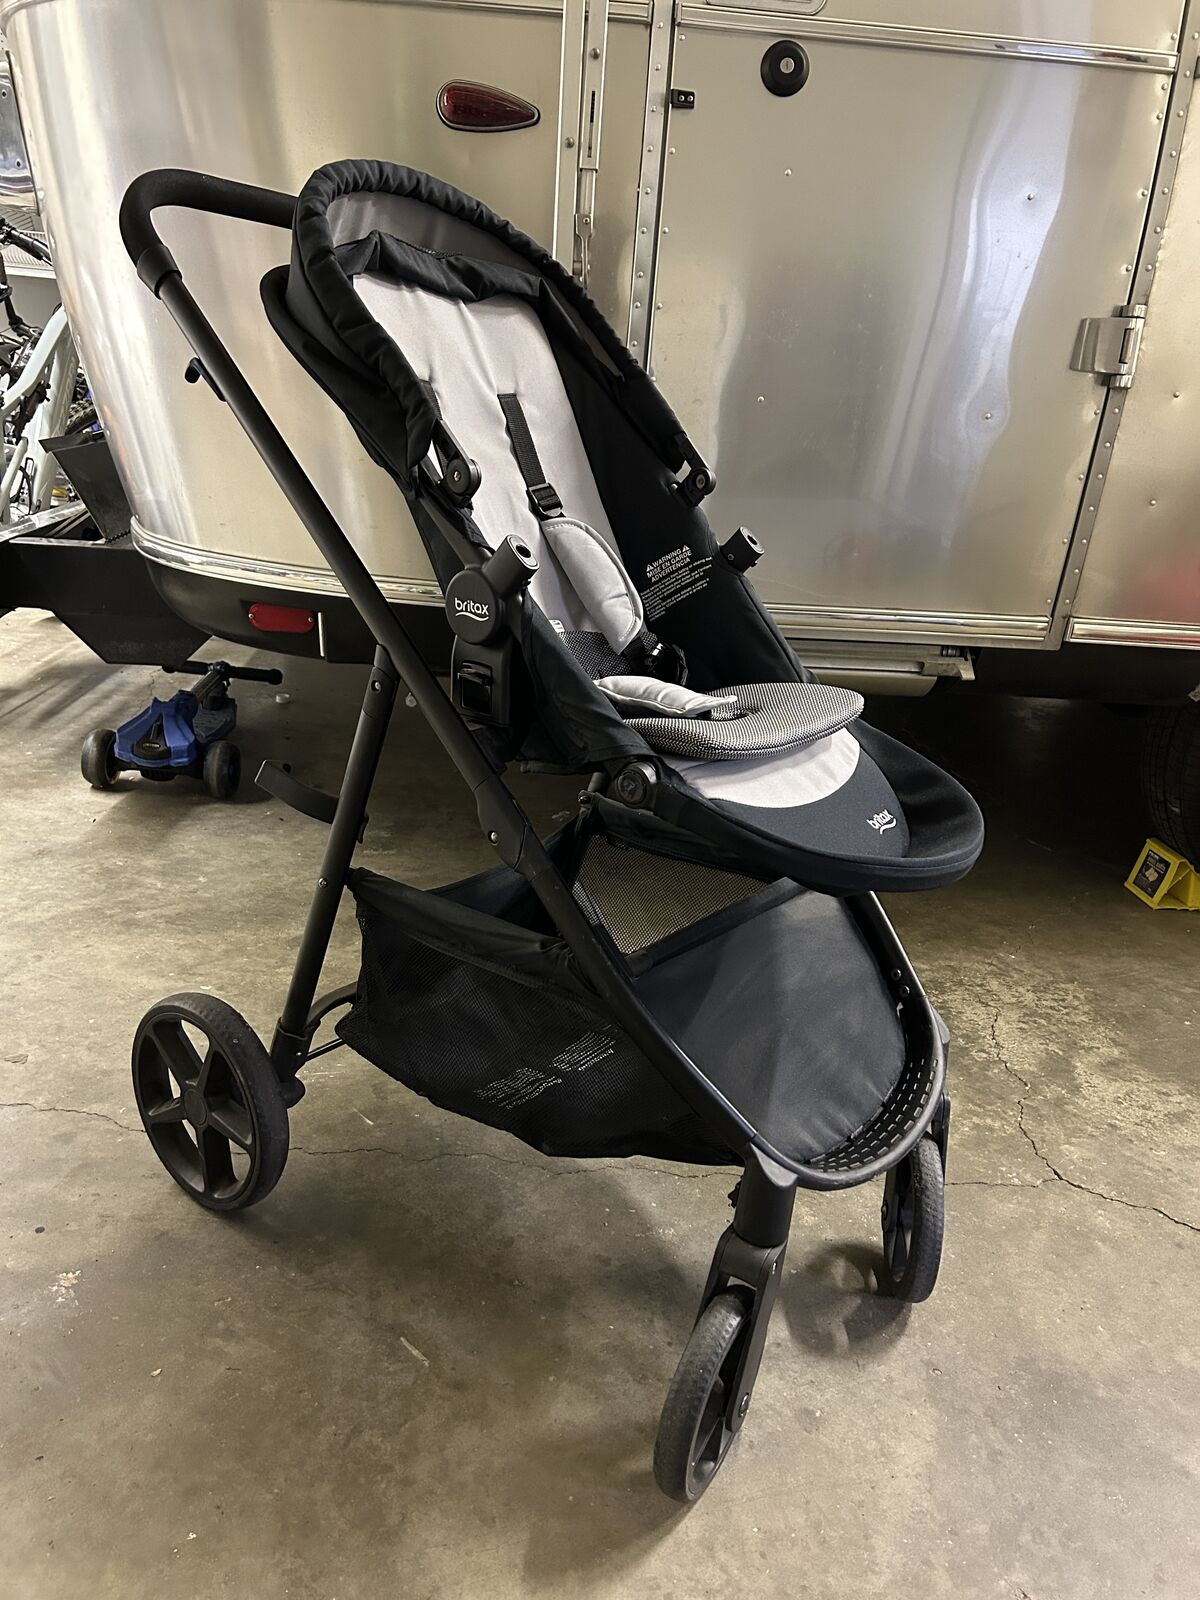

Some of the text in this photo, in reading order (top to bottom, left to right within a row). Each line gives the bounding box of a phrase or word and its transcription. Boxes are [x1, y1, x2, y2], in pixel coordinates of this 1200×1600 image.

[647, 550, 692, 578] MISE EN GARDE
[652, 549, 681, 568] WARNING
[652, 557, 691, 583] ADVERTENCIA
[454, 597, 489, 615] britax
[866, 809, 893, 830] britax
